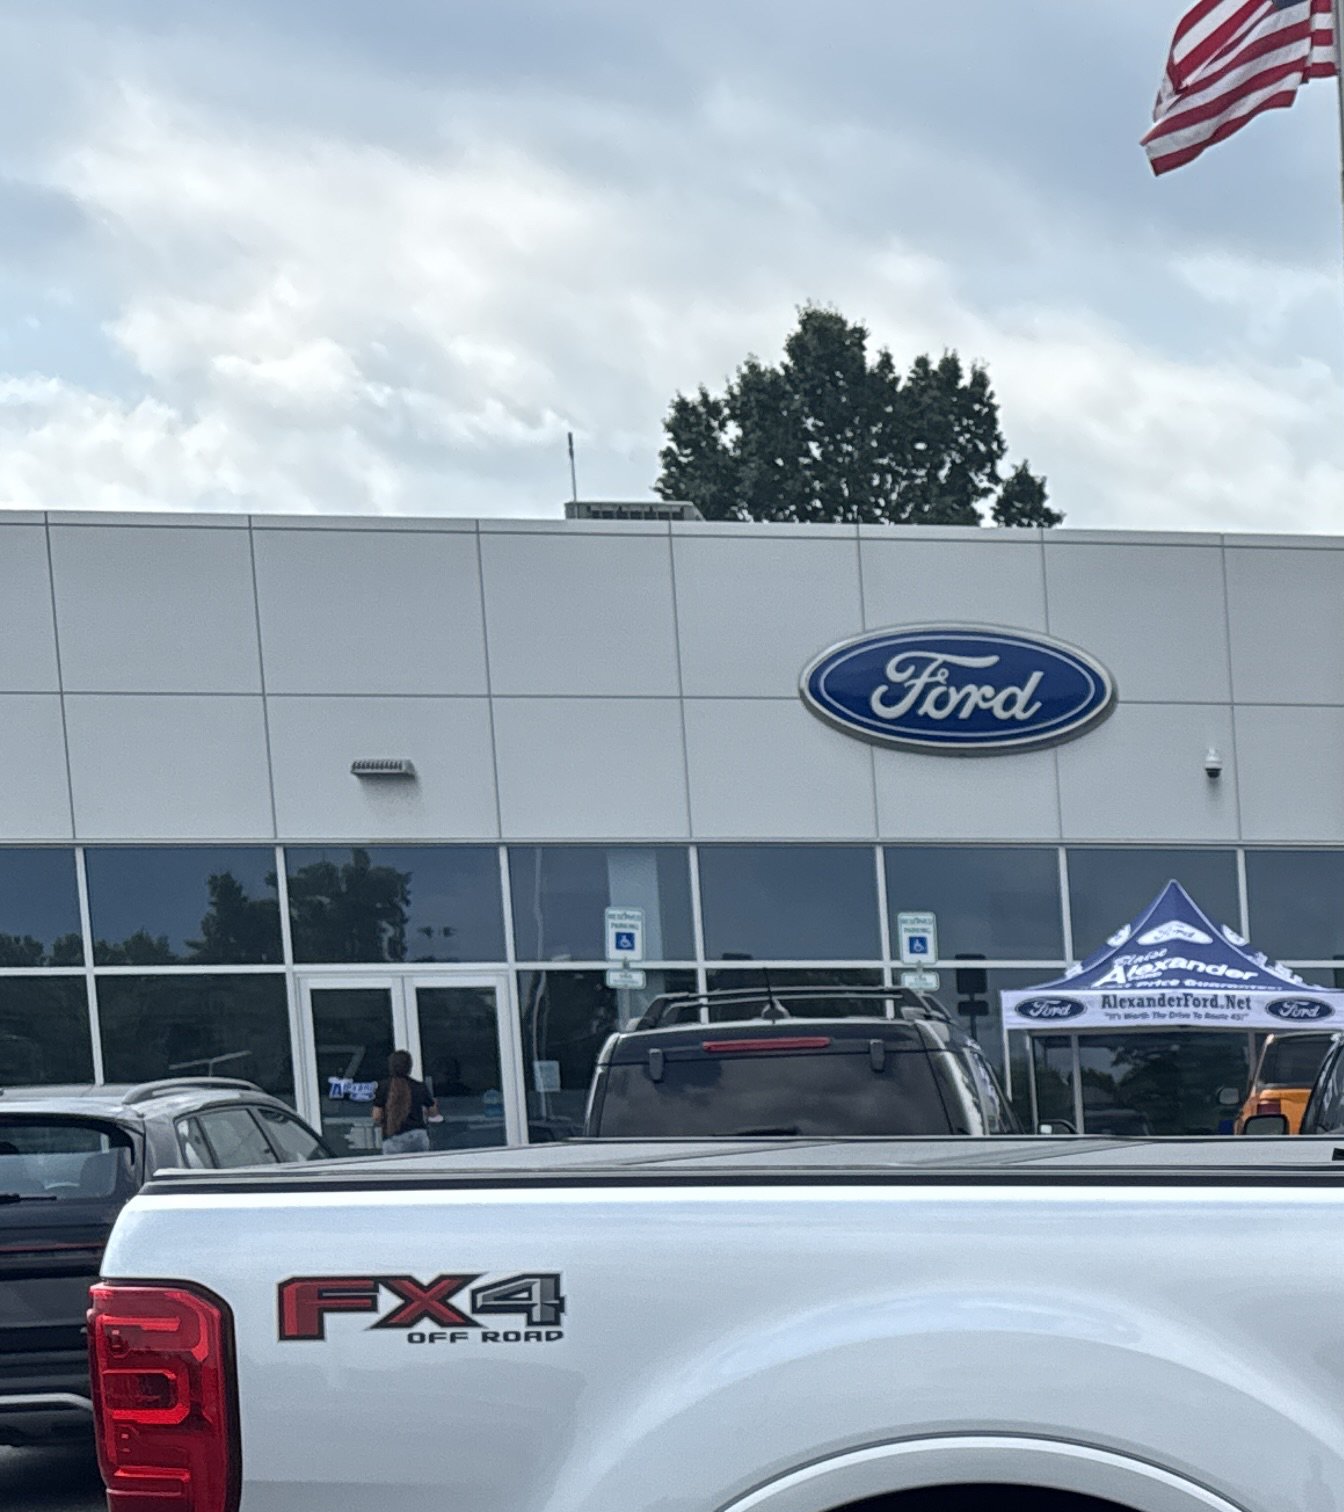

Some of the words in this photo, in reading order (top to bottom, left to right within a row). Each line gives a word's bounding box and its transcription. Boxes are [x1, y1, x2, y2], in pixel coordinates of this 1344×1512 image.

[871, 651, 1044, 720] Ford
[1090, 957, 1259, 987] Alexander
[1029, 1000, 1072, 1017] Ford
[1101, 993, 1252, 1010] AlexanderFord.Net
[1280, 1001, 1321, 1018] Ford
[277, 1271, 566, 1341] FX4
[407, 1332, 468, 1343] OFF
[482, 1331, 563, 1342] ROAD
